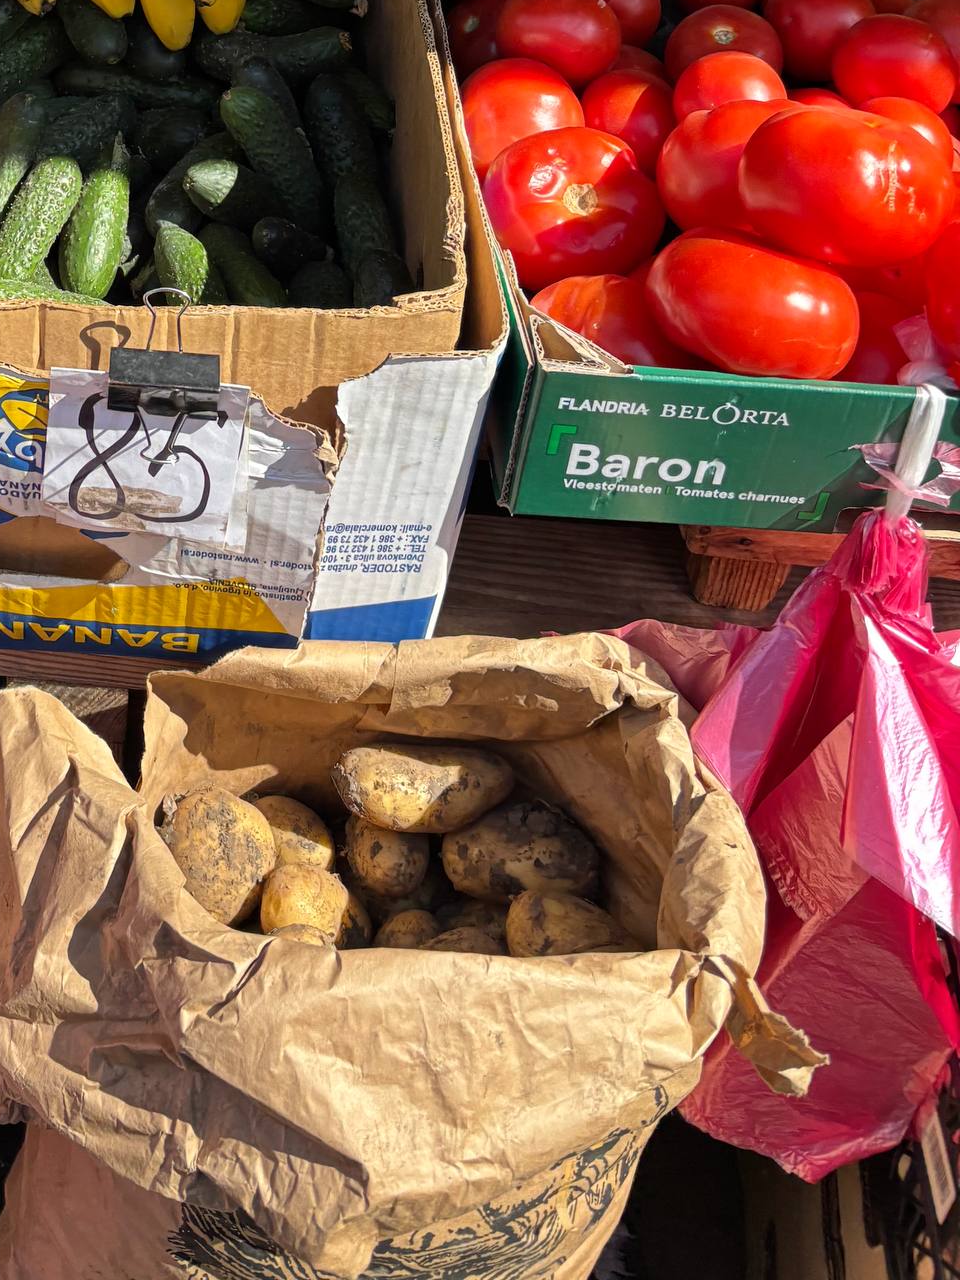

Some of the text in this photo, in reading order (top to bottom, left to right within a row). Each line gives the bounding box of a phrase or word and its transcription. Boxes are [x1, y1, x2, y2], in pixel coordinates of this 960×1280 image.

[558, 397, 650, 416] FLANDRIA
[69, 391, 229, 523] 85
[565, 442, 727, 486] Baron
[563, 478, 806, 505] Vleestomaten Tomates charnues
[399, 524, 432, 533] e-mail:
[327, 535, 339, 544] 99
[340, 535, 351, 543] 73
[352, 535, 370, 543] 432
[378, 535, 396, 543] 386
[405, 534, 430, 543] FAX.:
[326, 545, 337, 554] 96
[339, 544, 350, 553] 73
[351, 544, 368, 553] 432
[377, 544, 394, 553] 386
[403, 544, 427, 553] TEL.:
[180, 548, 260, 566] www.rastoder.si
[320, 554, 338, 563] 100
[354, 553, 375, 563] ulica
[377, 553, 425, 562] Dvorakova
[327, 563, 358, 572] družba
[360, 562, 422, 573] RASTODER,
[172, 582, 198, 592] d.o.o.
[200, 583, 241, 596] trgovino,
[259, 583, 304, 596] Ljubljana,
[254, 590, 303, 602] gostinstvo
